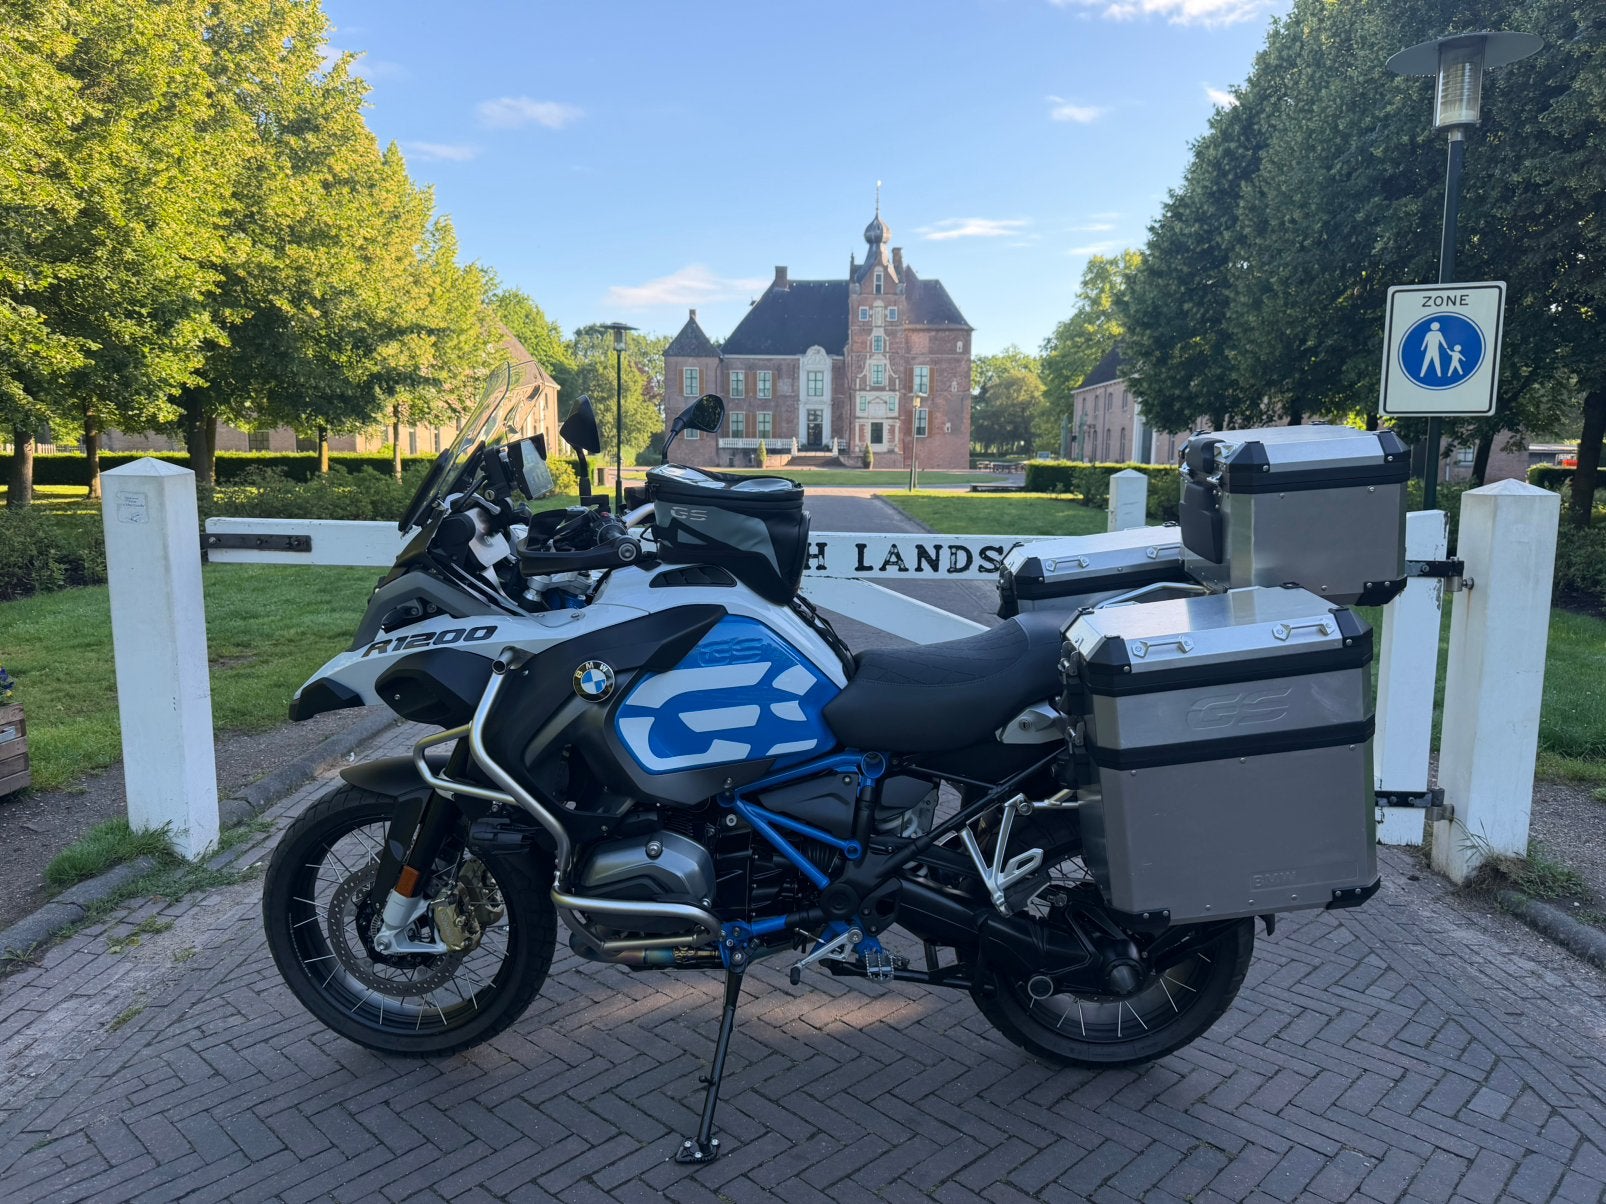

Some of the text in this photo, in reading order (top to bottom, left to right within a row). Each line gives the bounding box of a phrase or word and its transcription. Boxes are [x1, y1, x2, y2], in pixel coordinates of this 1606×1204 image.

[1421, 294, 1470, 308] ZONE
[670, 506, 709, 521] GS
[854, 543, 1004, 574] LANDS
[361, 625, 499, 658] R1200
[699, 637, 764, 668] GS
[575, 661, 608, 679] BMW
[1185, 687, 1293, 730] GS
[1252, 871, 1297, 888] BMW
